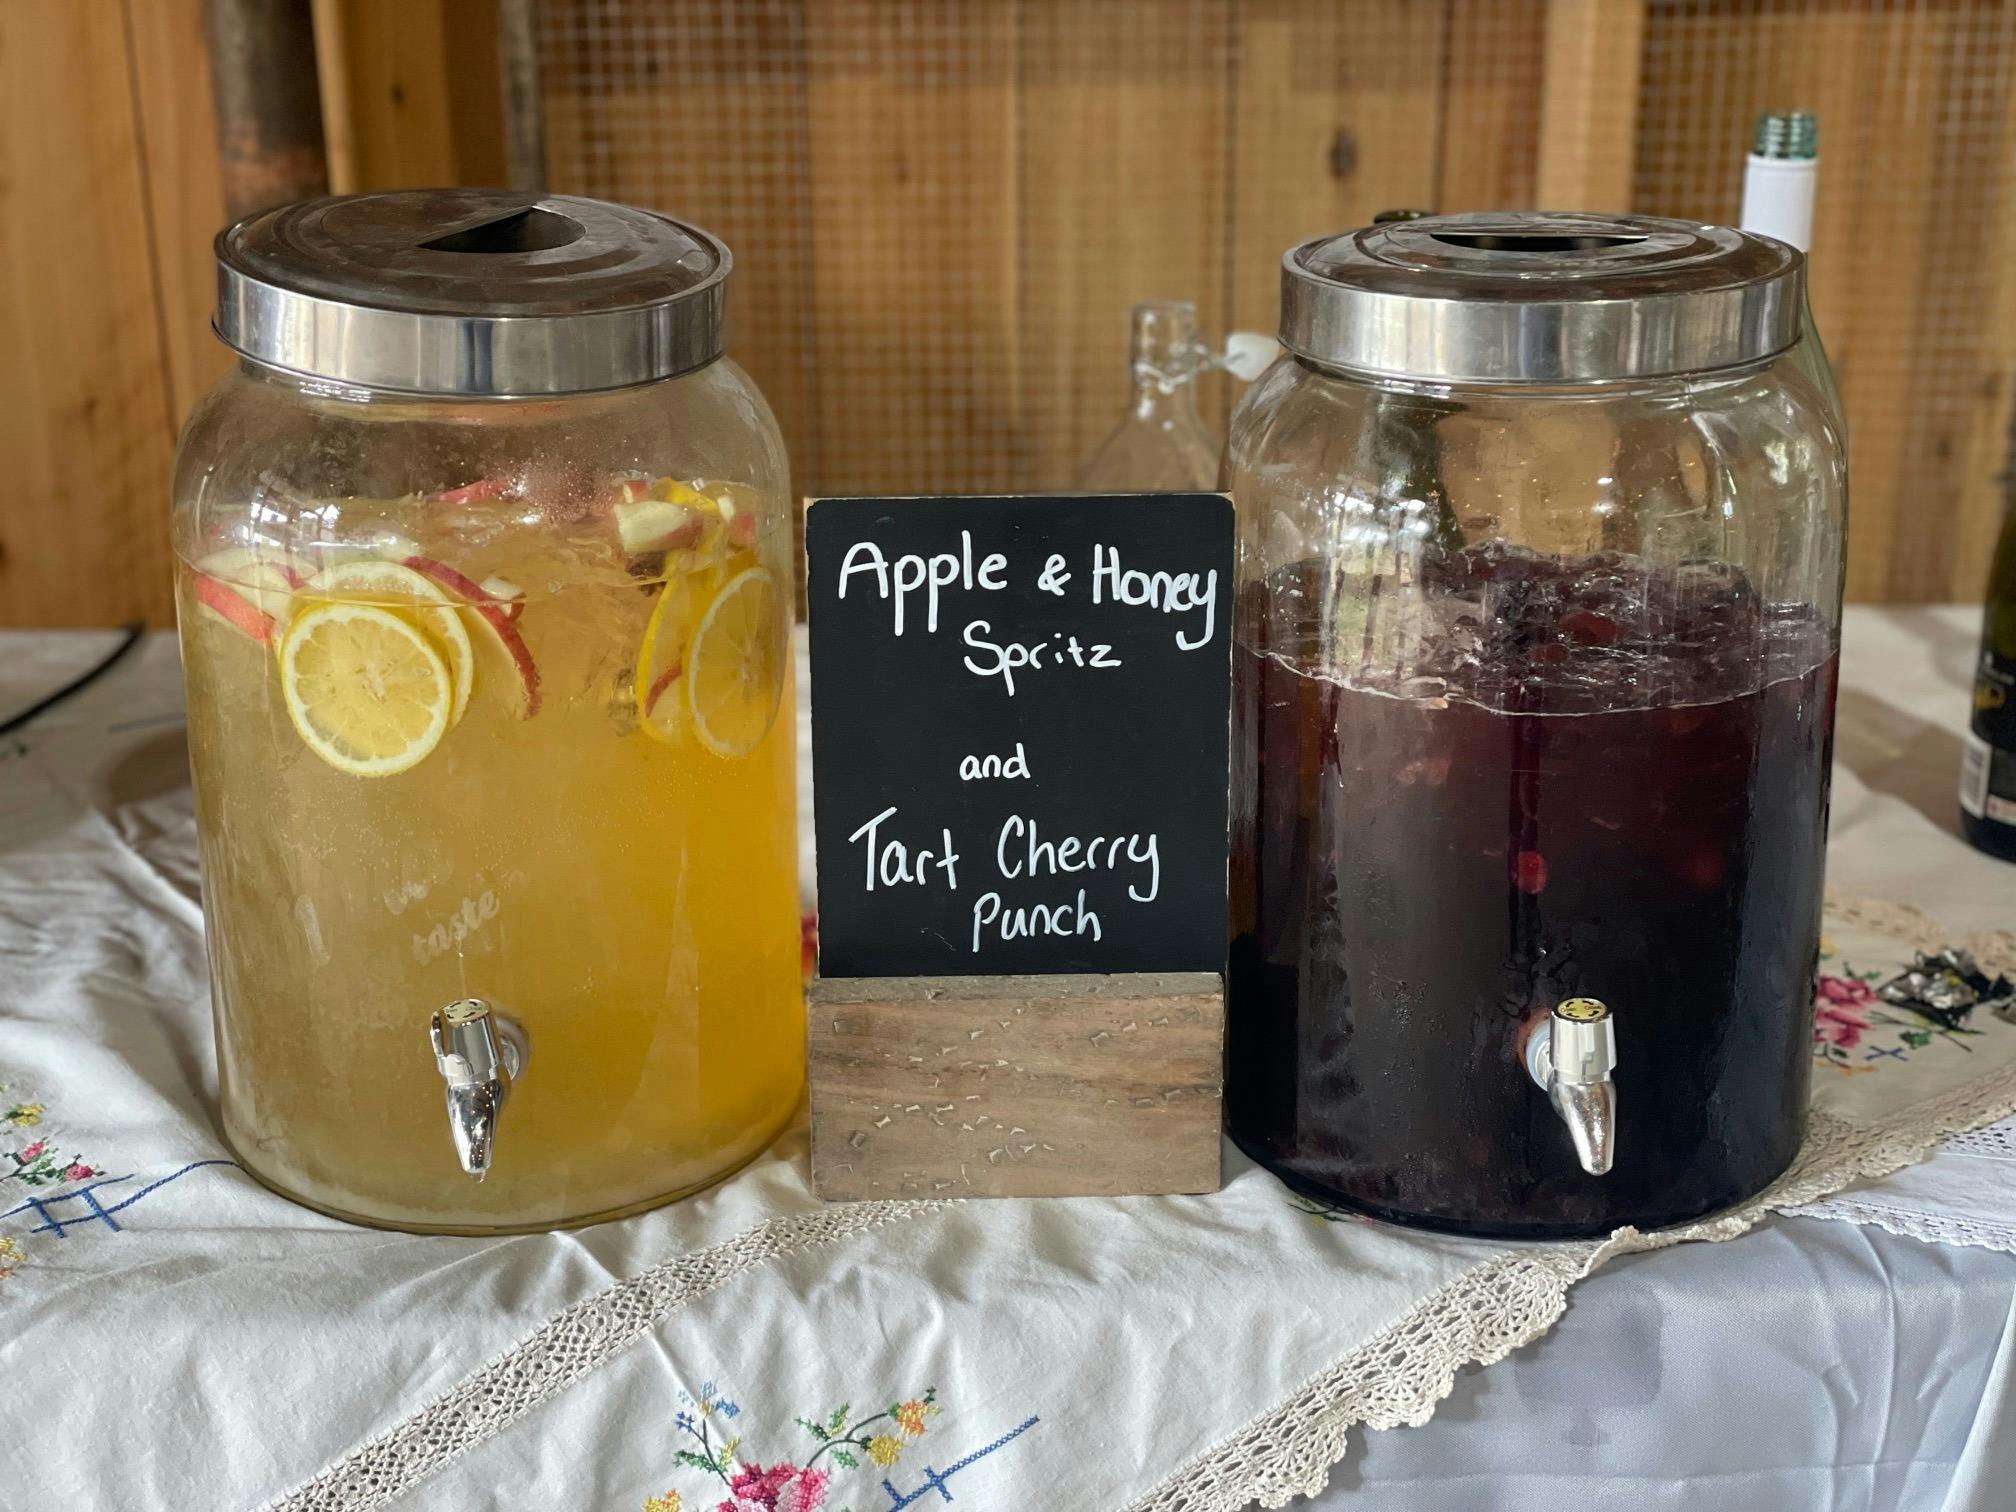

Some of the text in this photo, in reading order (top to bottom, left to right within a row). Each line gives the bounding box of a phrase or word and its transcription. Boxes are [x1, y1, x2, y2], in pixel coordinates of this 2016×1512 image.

[838, 529, 1218, 651] Apple & Honey
[963, 619, 1122, 697] Spritz
[959, 742, 1031, 781] and
[847, 806, 1160, 903] Tart Cherry
[972, 888, 1102, 953] Punch
